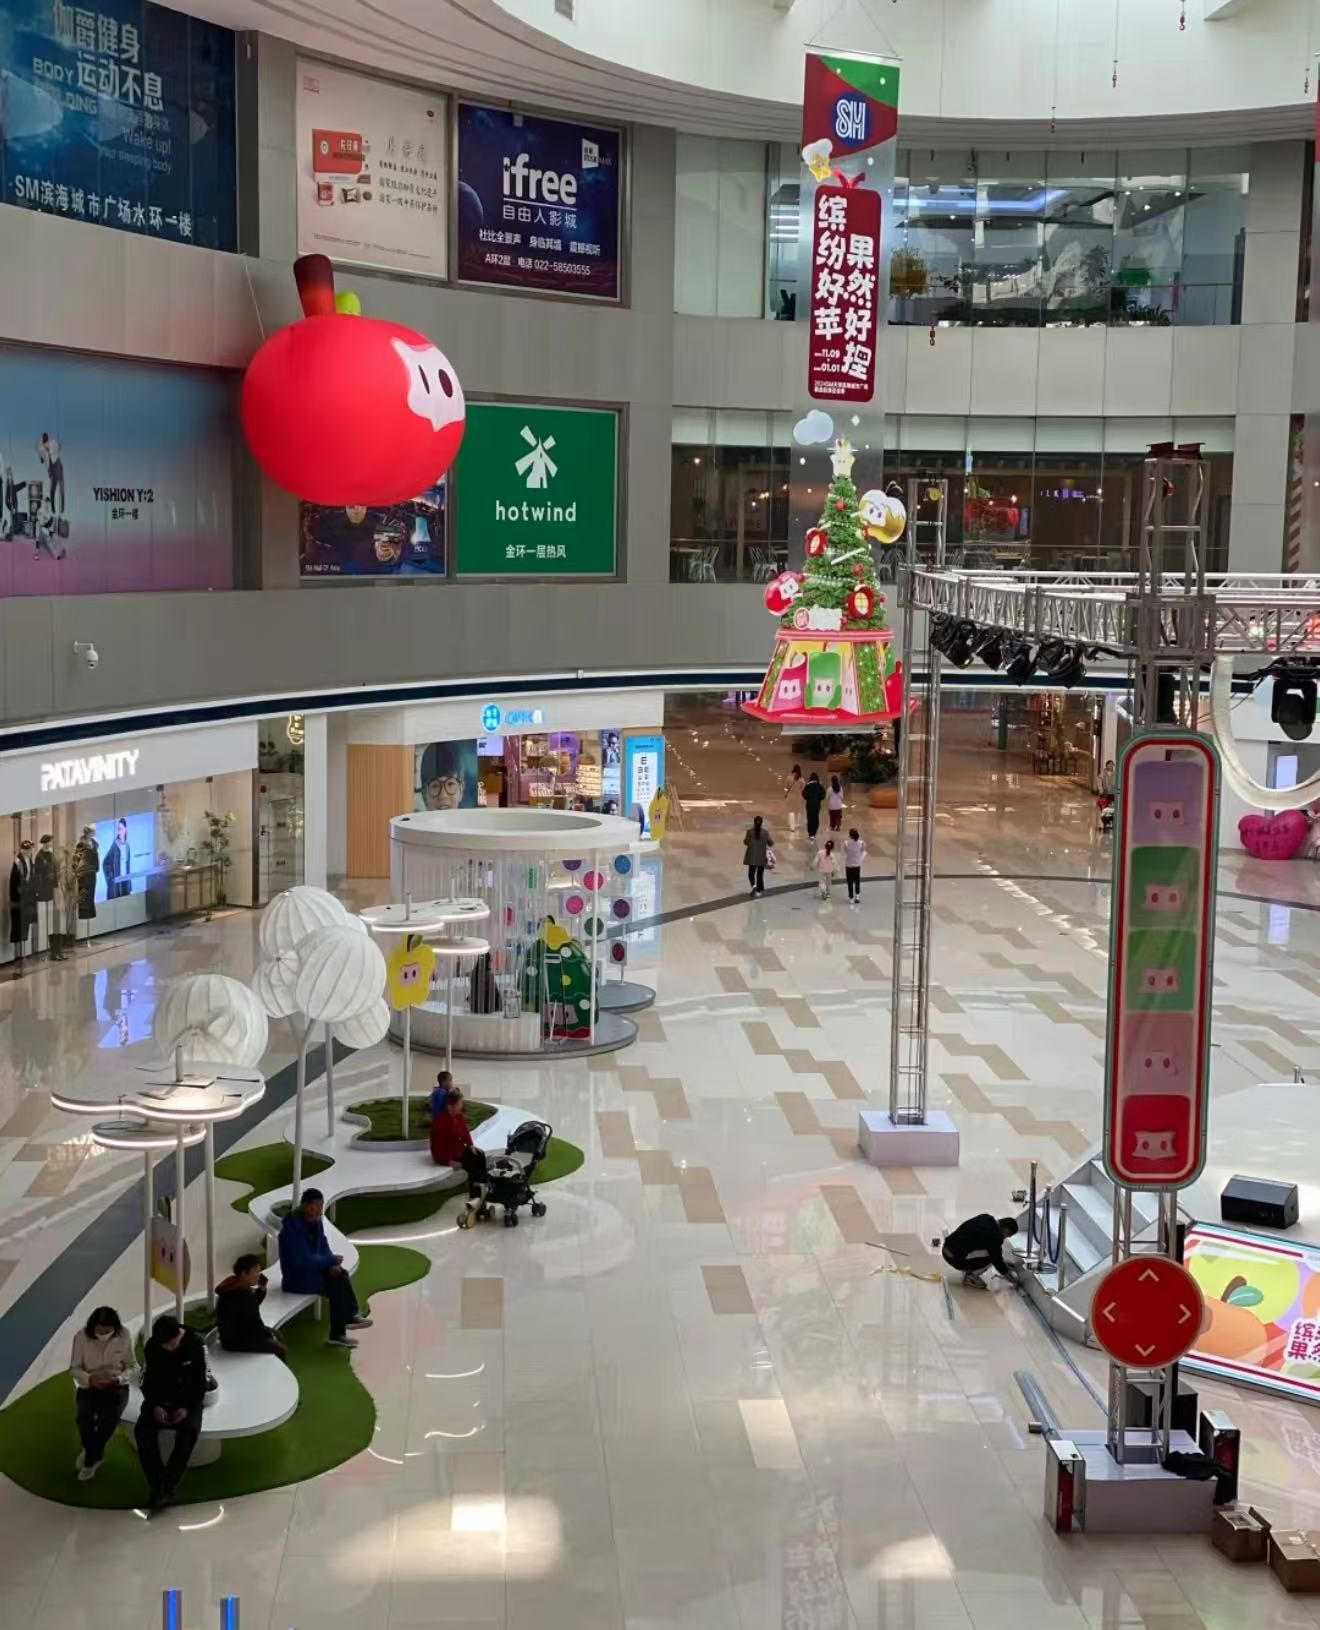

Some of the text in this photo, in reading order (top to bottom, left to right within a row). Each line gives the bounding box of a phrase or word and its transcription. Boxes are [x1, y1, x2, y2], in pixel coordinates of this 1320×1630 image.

[33, 57, 74, 86] BODY
[77, 51, 163, 111] 运动不息
[503, 153, 577, 205] ifree
[503, 205, 577, 229] 自由人影城
[814, 194, 847, 340] 缤纷好苹
[93, 487, 135, 502] YISHION
[496, 500, 577, 521] hotwind
[505, 544, 567, 559] 金环一层热风
[41, 748, 139, 792] PATAVINITY
